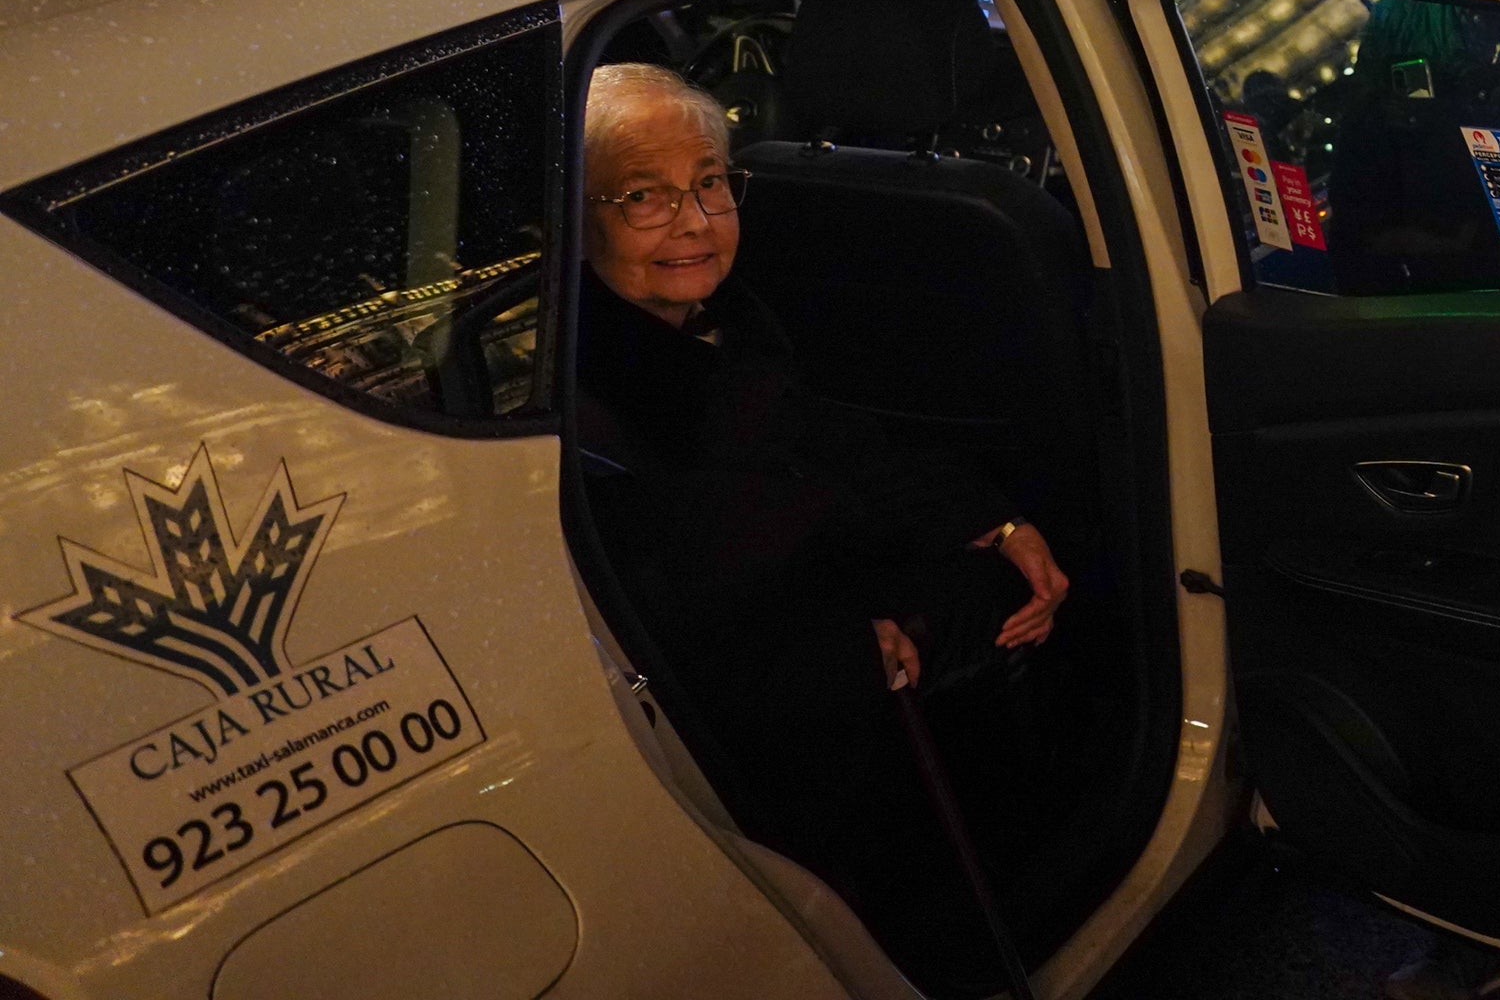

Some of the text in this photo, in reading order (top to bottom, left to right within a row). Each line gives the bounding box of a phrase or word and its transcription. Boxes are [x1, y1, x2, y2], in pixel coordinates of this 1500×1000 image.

[1237, 132, 1255, 142] VISA
[130, 644, 395, 781] CAJA RURAL
[188, 698, 390, 803] www.taxi-salamanca.com
[143, 698, 462, 888] 923 25 00 00
